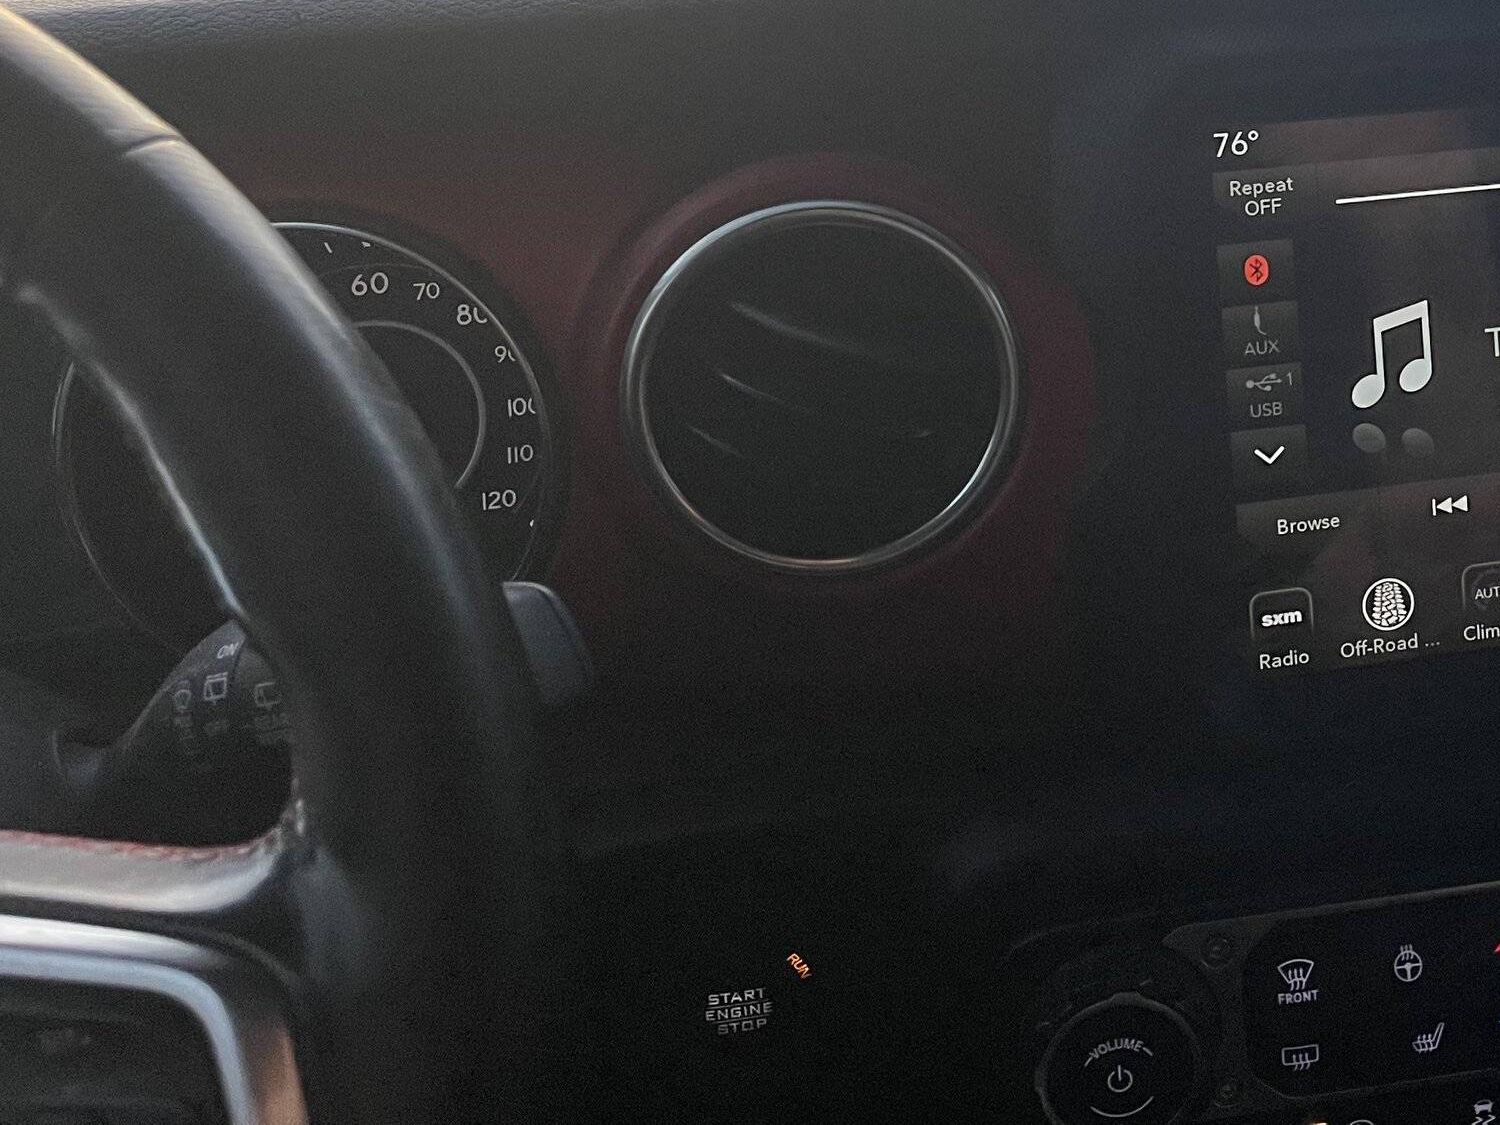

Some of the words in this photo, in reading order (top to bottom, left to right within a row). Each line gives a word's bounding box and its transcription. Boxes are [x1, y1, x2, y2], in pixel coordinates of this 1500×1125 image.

[1214, 131, 1258, 157] 76°
[1230, 178, 1294, 202] Repeat
[1245, 198, 1281, 216] OFF
[352, 273, 388, 295] 60
[414, 283, 439, 300] 70
[1245, 340, 1279, 355] AUX
[1250, 402, 1282, 417] USB
[508, 445, 533, 464] 110
[482, 490, 516, 510] 120
[1278, 517, 1339, 534] Browse
[1262, 611, 1302, 626] sxm
[1341, 633, 1418, 657] Off-Road
[1260, 650, 1309, 669] Radio
[787, 953, 812, 980] RUN
[708, 988, 766, 1005] START
[1278, 990, 1319, 1004] FRONT
[706, 1002, 773, 1021] ENGINE
[717, 1018, 767, 1035] STOP
[1090, 1038, 1143, 1059] VOLUME
